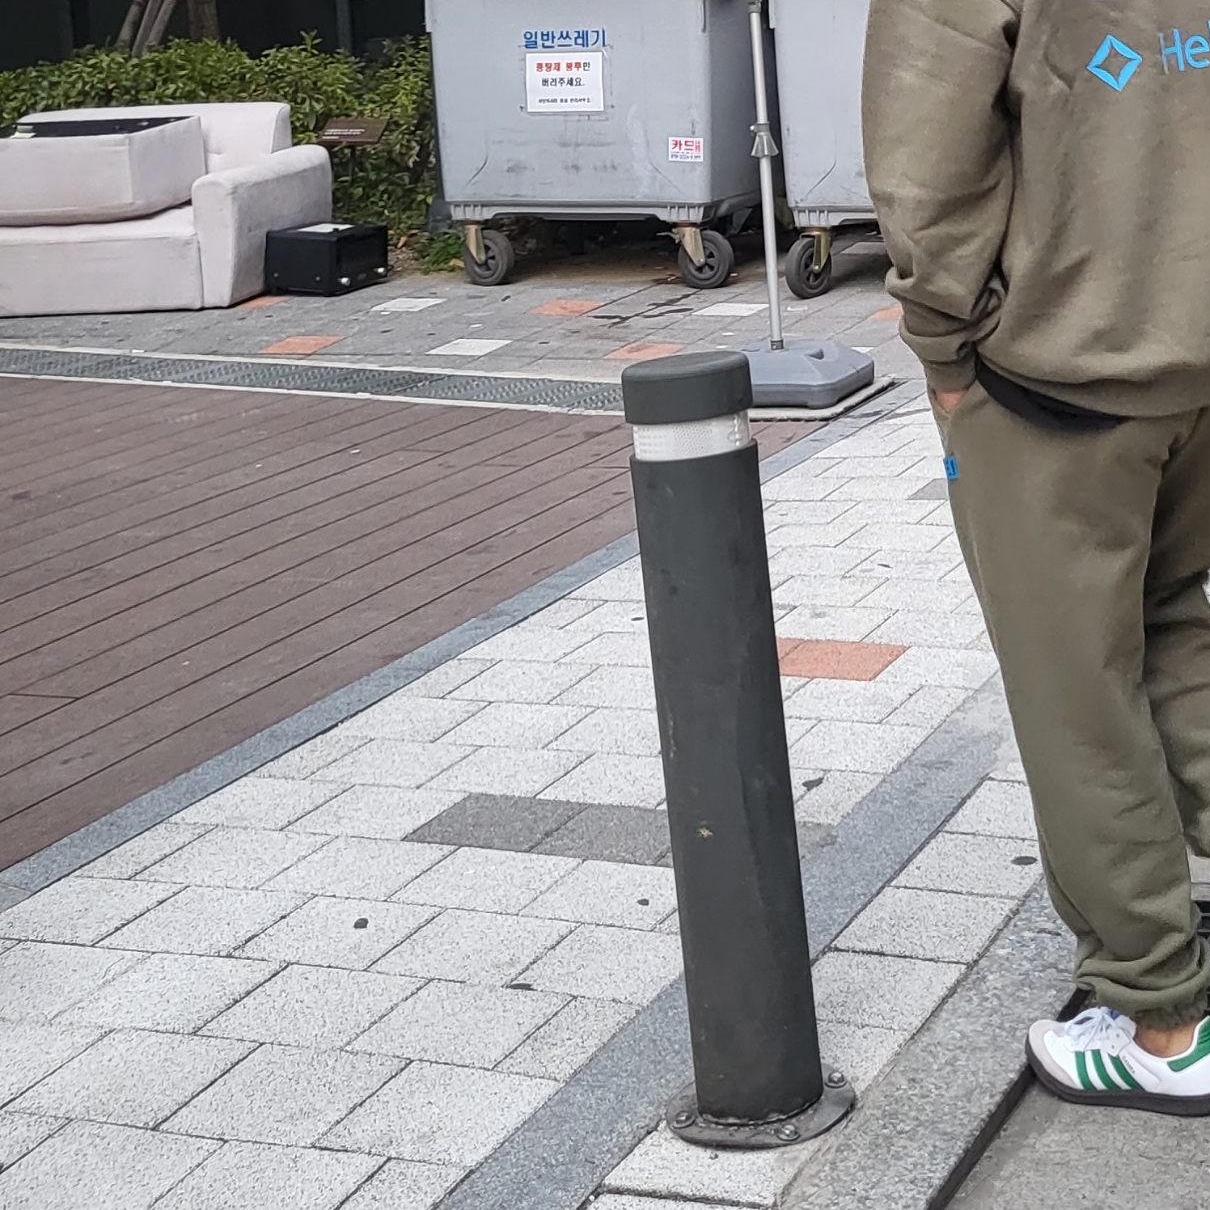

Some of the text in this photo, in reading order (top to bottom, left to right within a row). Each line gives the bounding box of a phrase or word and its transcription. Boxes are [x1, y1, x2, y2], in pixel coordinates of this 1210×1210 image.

[523, 29, 607, 49] 일반쓰레기
[541, 77, 585, 87] 버려주세요.
[671, 139, 694, 151] 카드
